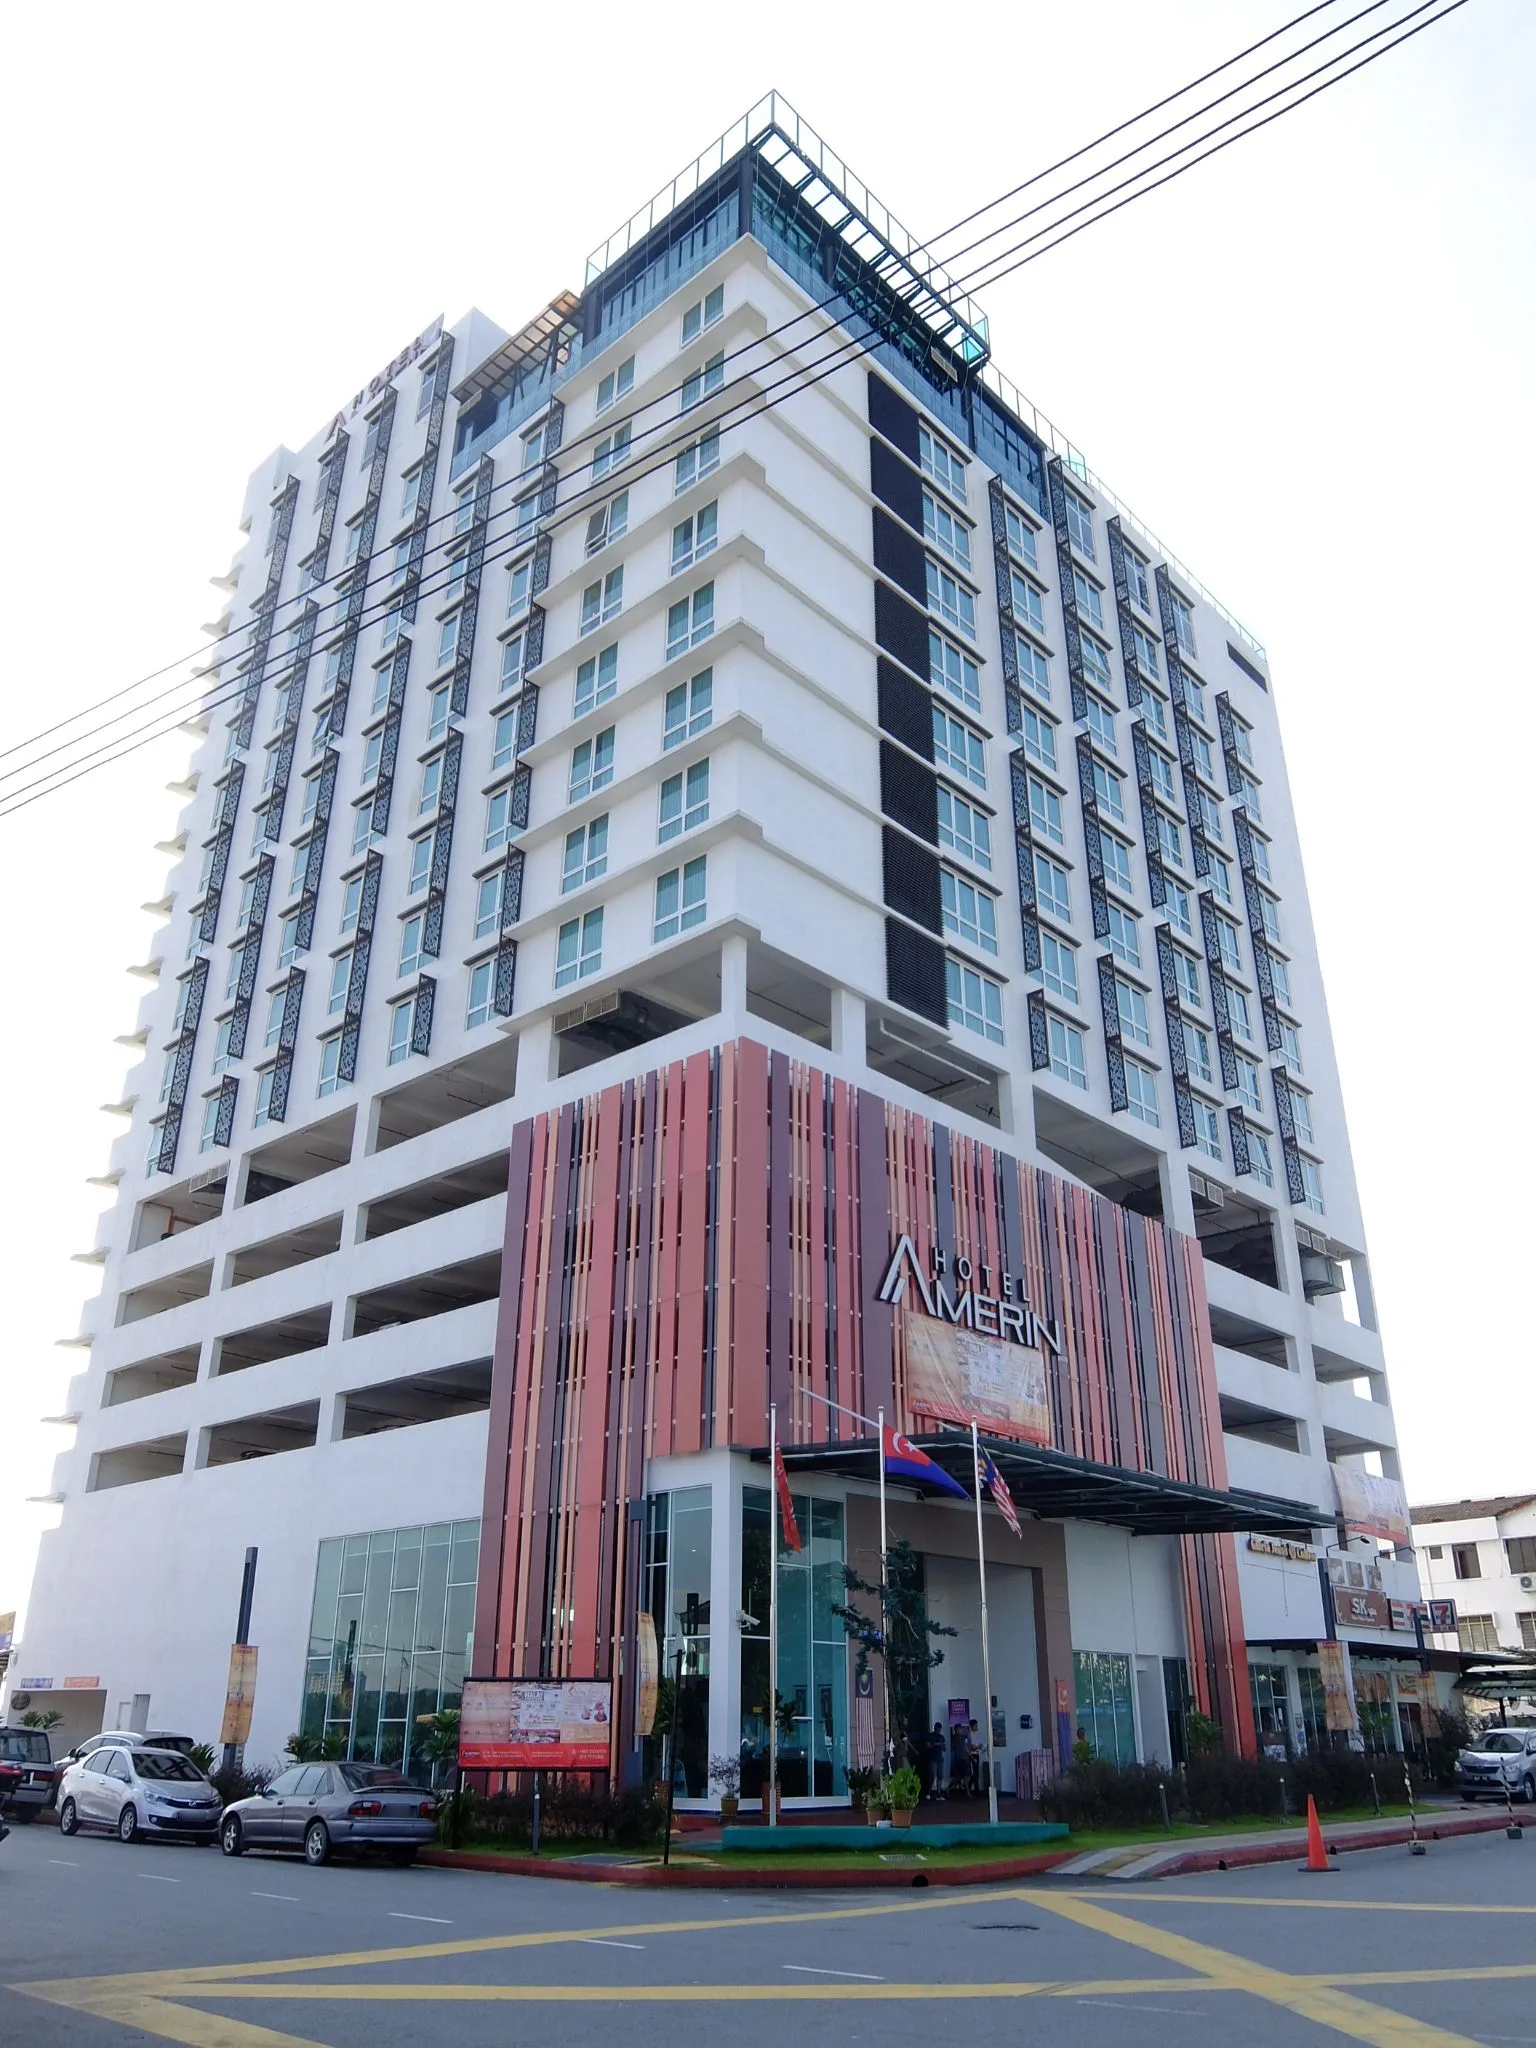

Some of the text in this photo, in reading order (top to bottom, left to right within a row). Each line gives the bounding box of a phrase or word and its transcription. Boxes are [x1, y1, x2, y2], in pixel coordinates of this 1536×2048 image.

[879, 1233, 1062, 1355] AMERIN
[935, 1247, 1031, 1302] HOTEL
[1351, 1597, 1368, 1615] SK
